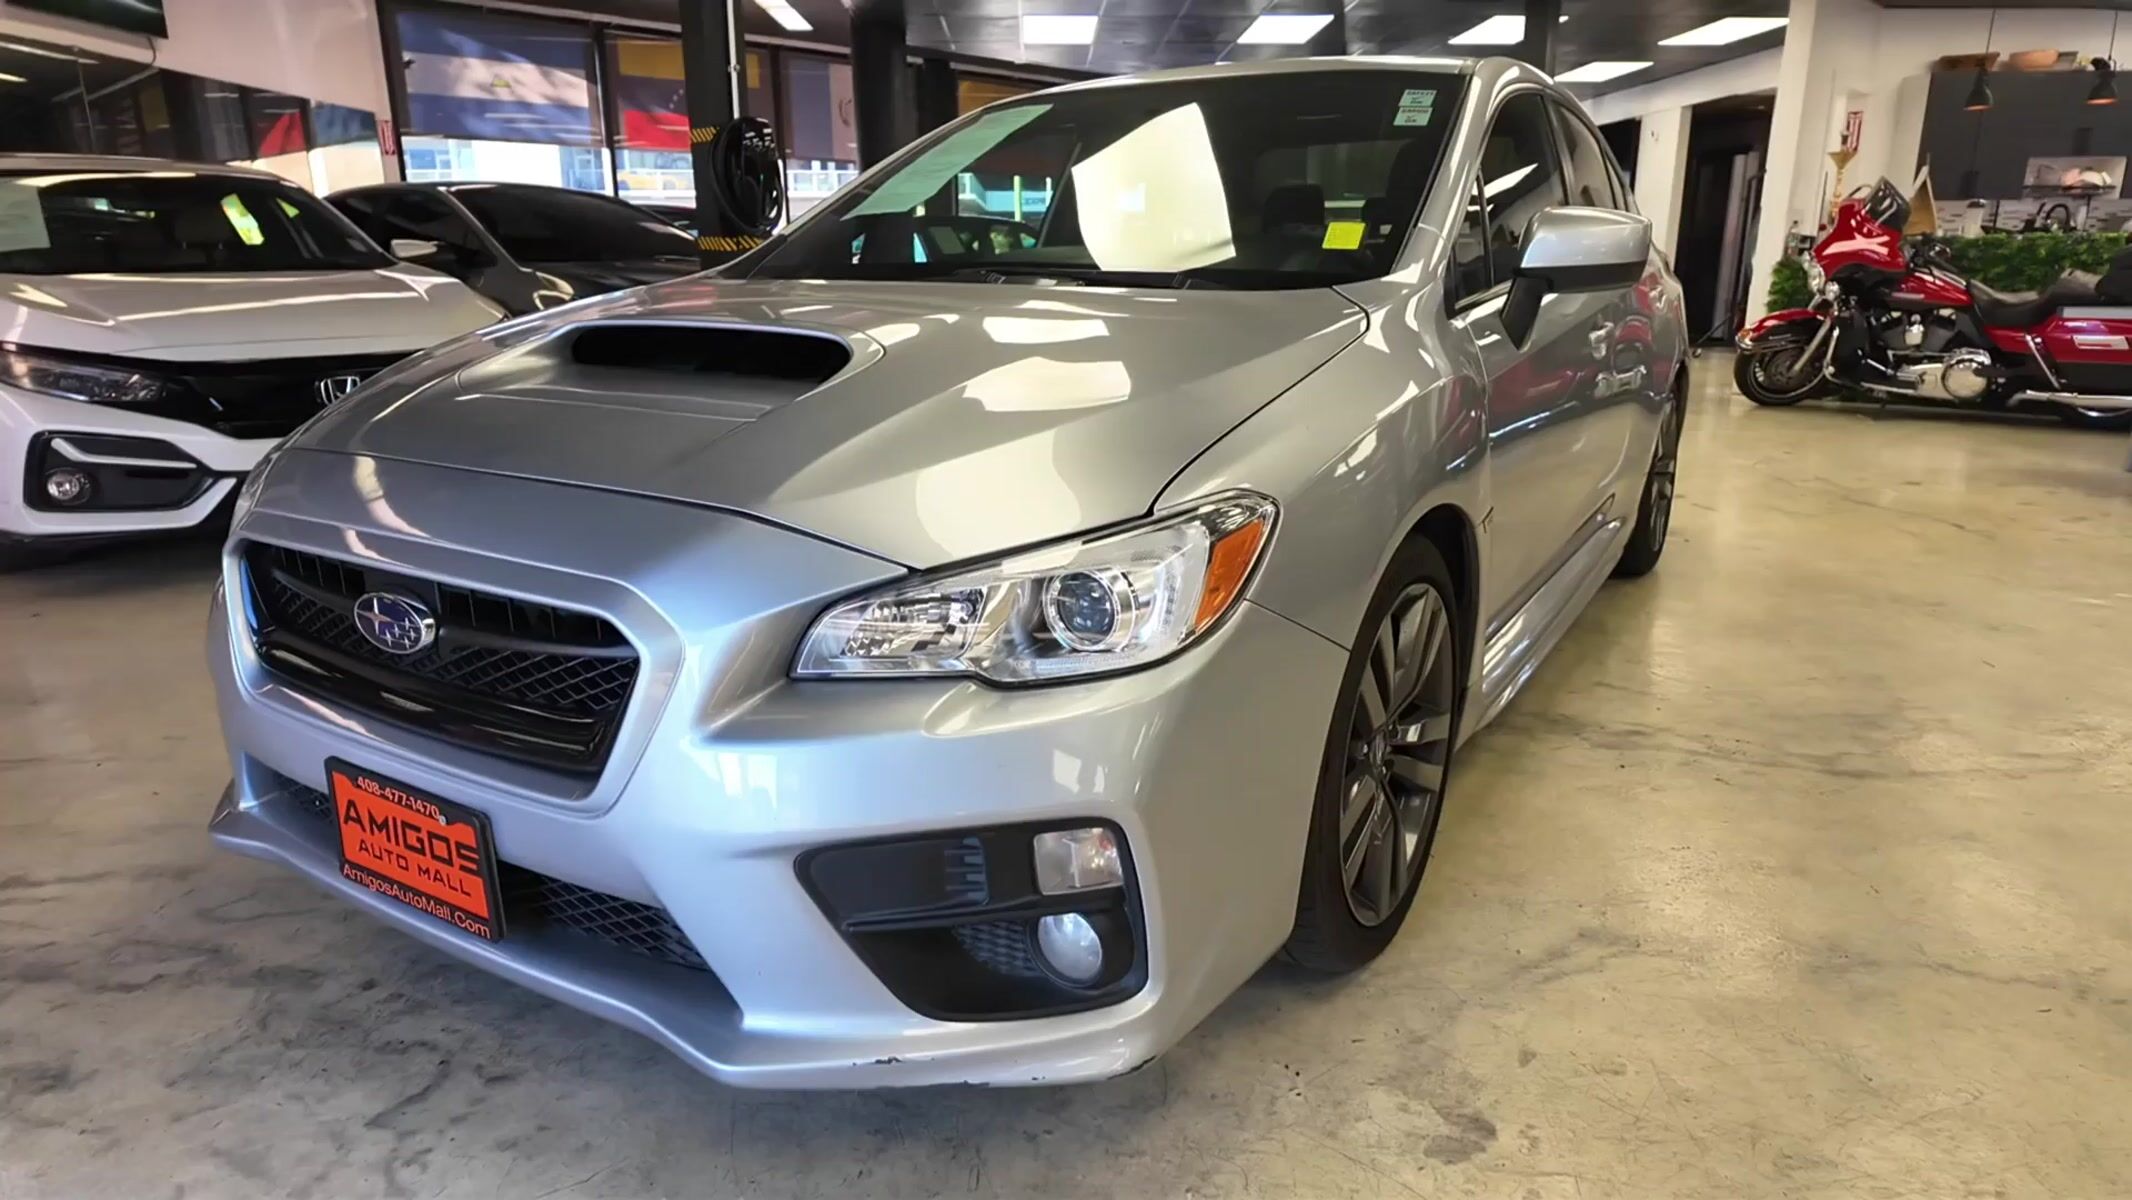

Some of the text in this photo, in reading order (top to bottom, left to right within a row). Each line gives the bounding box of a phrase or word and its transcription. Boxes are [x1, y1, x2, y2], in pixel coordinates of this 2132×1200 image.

[357, 776, 440, 818] 408-477-1470
[344, 800, 479, 874] AMIGOS
[359, 840, 472, 897] AUTO MALL
[344, 865, 490, 938] AmigosAutoMall.Com
